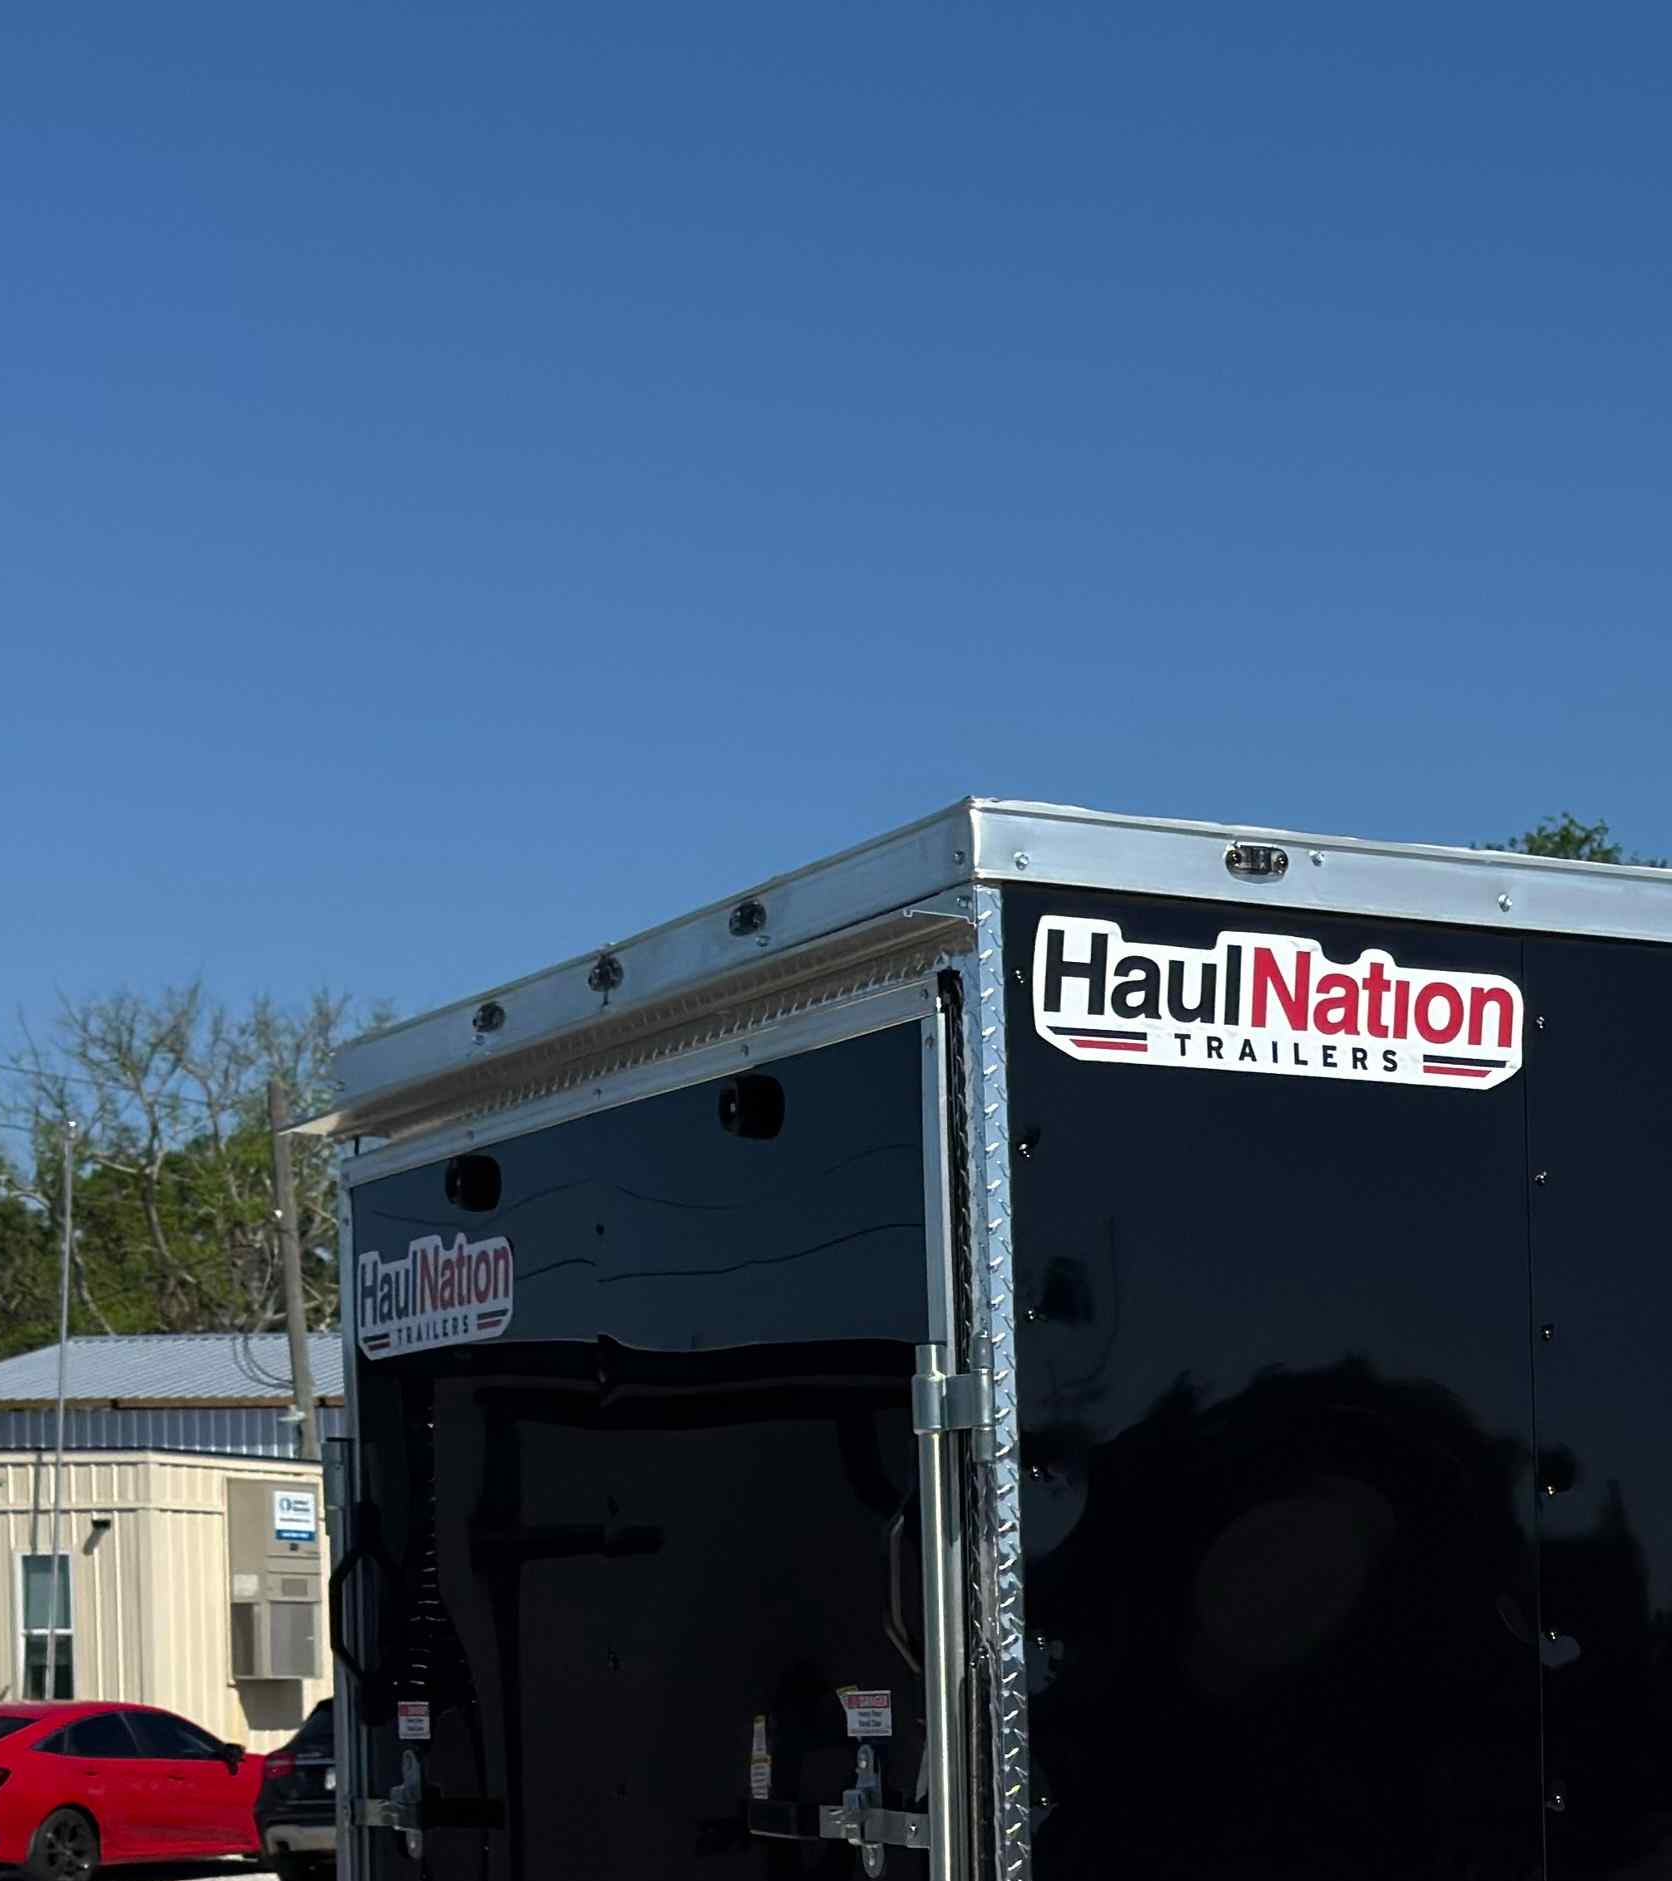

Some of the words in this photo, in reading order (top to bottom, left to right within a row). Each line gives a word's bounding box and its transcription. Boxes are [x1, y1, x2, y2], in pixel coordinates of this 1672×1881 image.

[1043, 928, 1515, 1049] HaulNation
[1173, 1032, 1398, 1073] TRAILERS
[360, 1243, 510, 1329] HaulNation
[396, 1314, 470, 1346] TRAILERS
